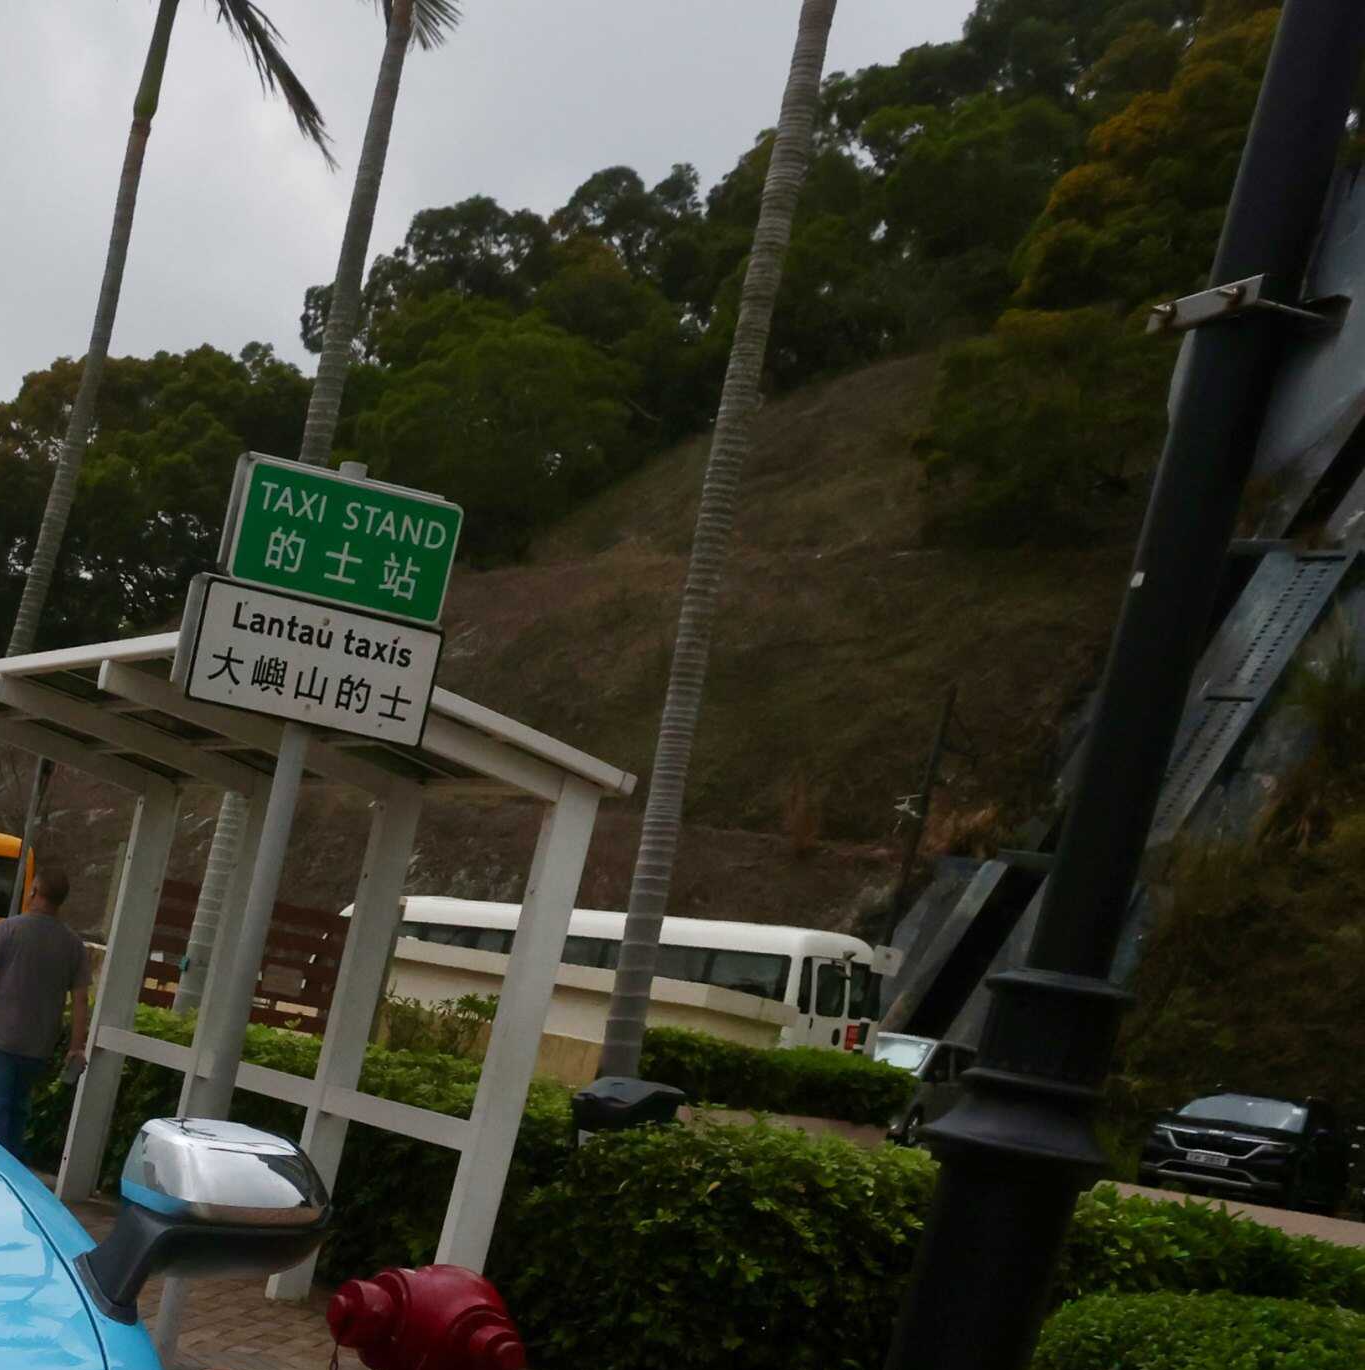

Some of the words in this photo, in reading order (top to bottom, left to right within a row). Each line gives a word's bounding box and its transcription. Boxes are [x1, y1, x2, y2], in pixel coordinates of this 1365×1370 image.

[260, 481, 328, 525] TAXI
[342, 502, 447, 550] STAND
[264, 526, 422, 601] 的士站
[232, 601, 333, 650] Lantau
[344, 629, 413, 669] taxis
[207, 647, 413, 724] 大嶼山的士
